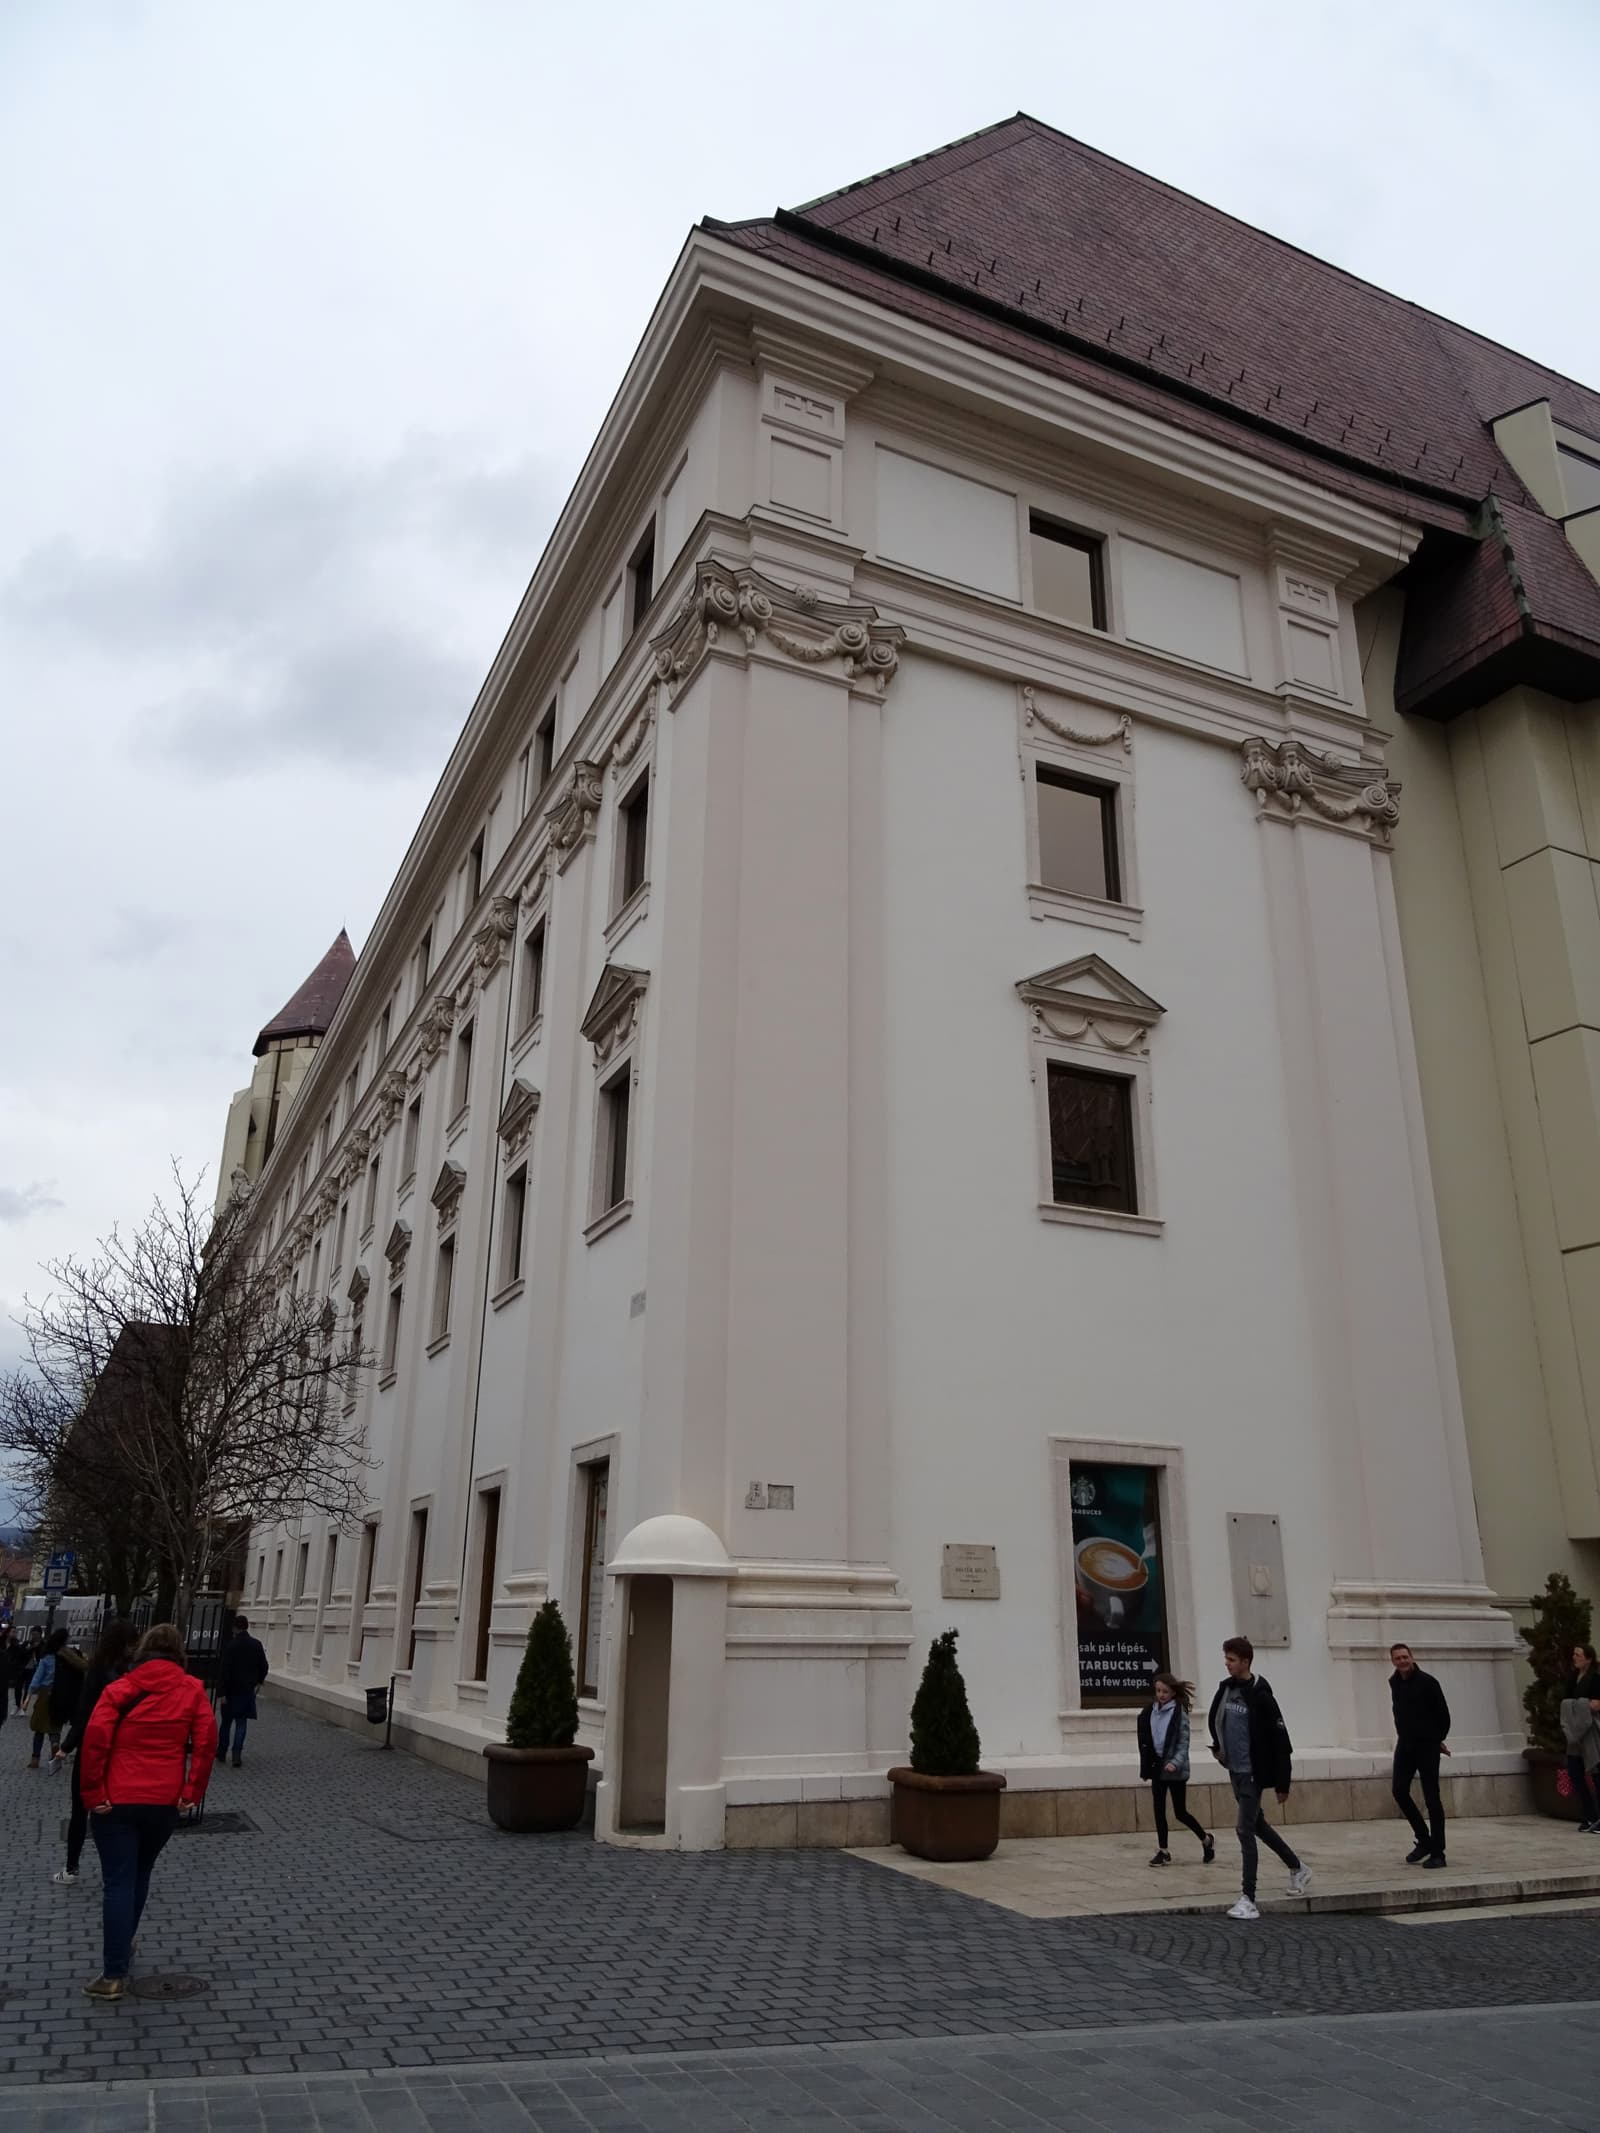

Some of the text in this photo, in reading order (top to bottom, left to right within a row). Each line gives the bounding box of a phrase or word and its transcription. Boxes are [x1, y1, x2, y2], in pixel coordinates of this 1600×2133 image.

[1072, 1508, 1102, 1516] ARBUCKS
[1079, 1641, 1148, 1655] sak pár lépés.
[1079, 1660, 1139, 1671] TARBUCKS
[1080, 1675, 1150, 1689] ust a few steps.
